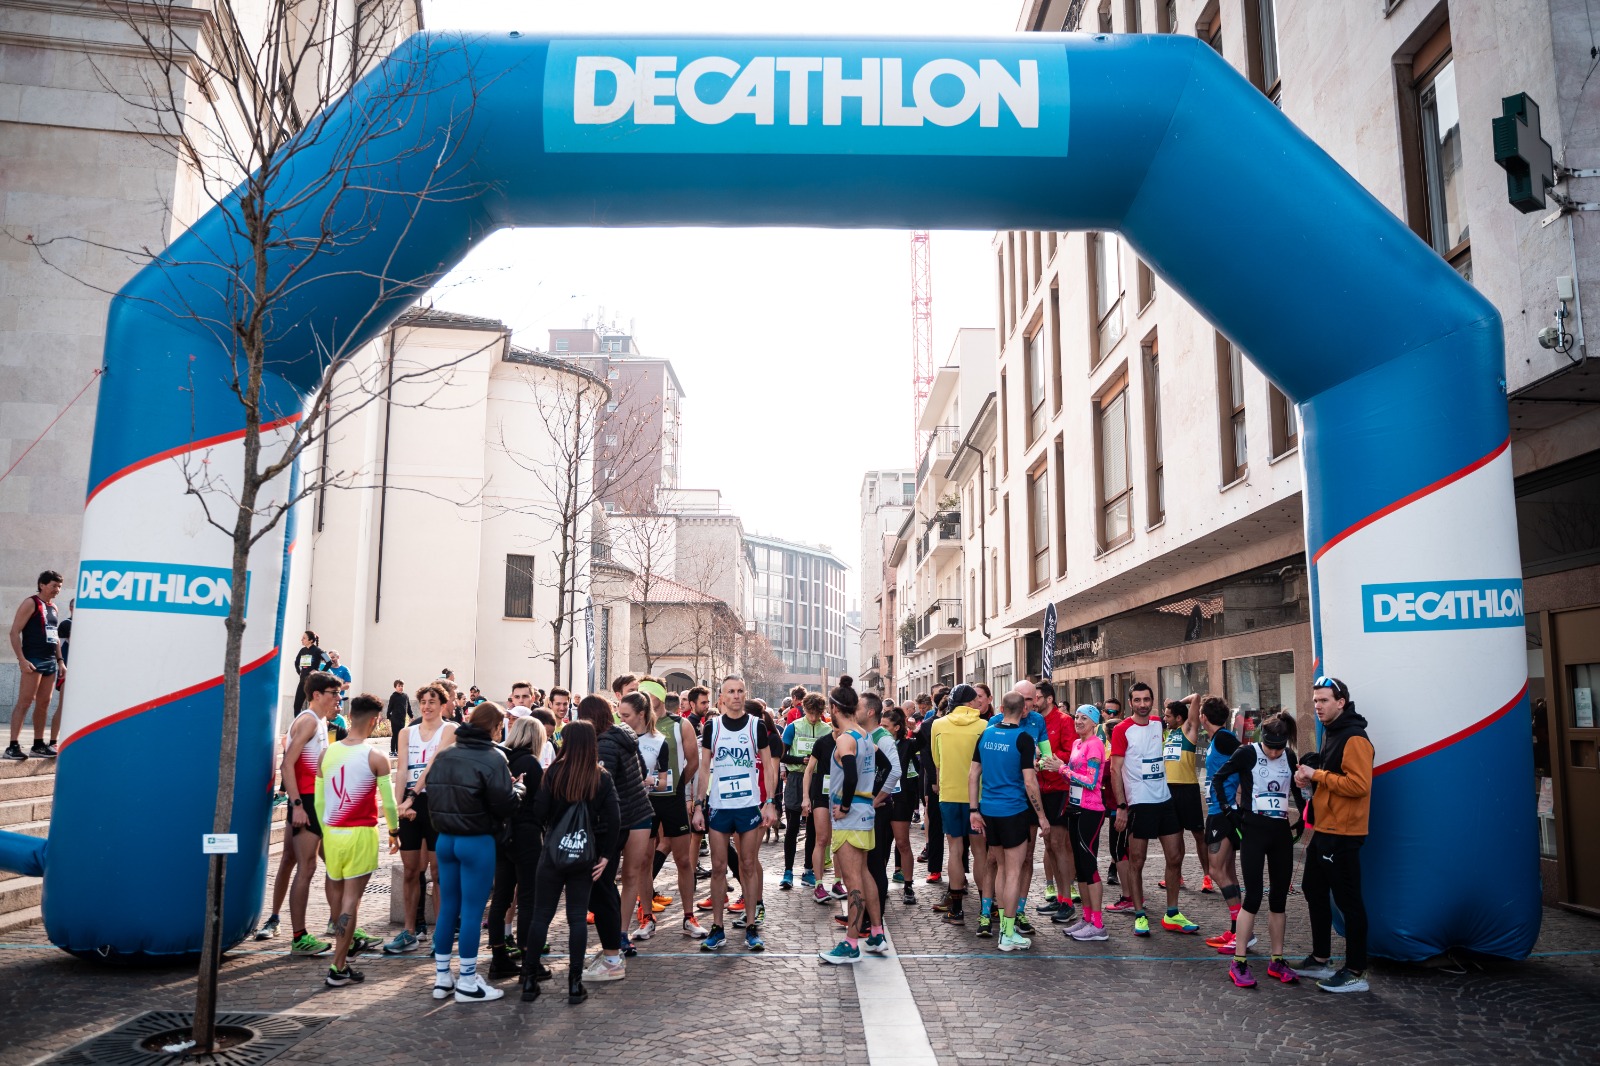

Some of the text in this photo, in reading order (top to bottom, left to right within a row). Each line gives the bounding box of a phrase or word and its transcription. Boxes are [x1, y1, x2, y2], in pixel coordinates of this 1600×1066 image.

[573, 55, 1040, 129] DECATHLON
[79, 570, 232, 607] DECATHLON
[1372, 588, 1524, 623] DECATHLON
[715, 746, 751, 762] ONDA
[732, 758, 754, 769] VERDE
[1150, 763, 1160, 773] 69
[729, 781, 741, 791] 11
[1267, 798, 1281, 809] 12
